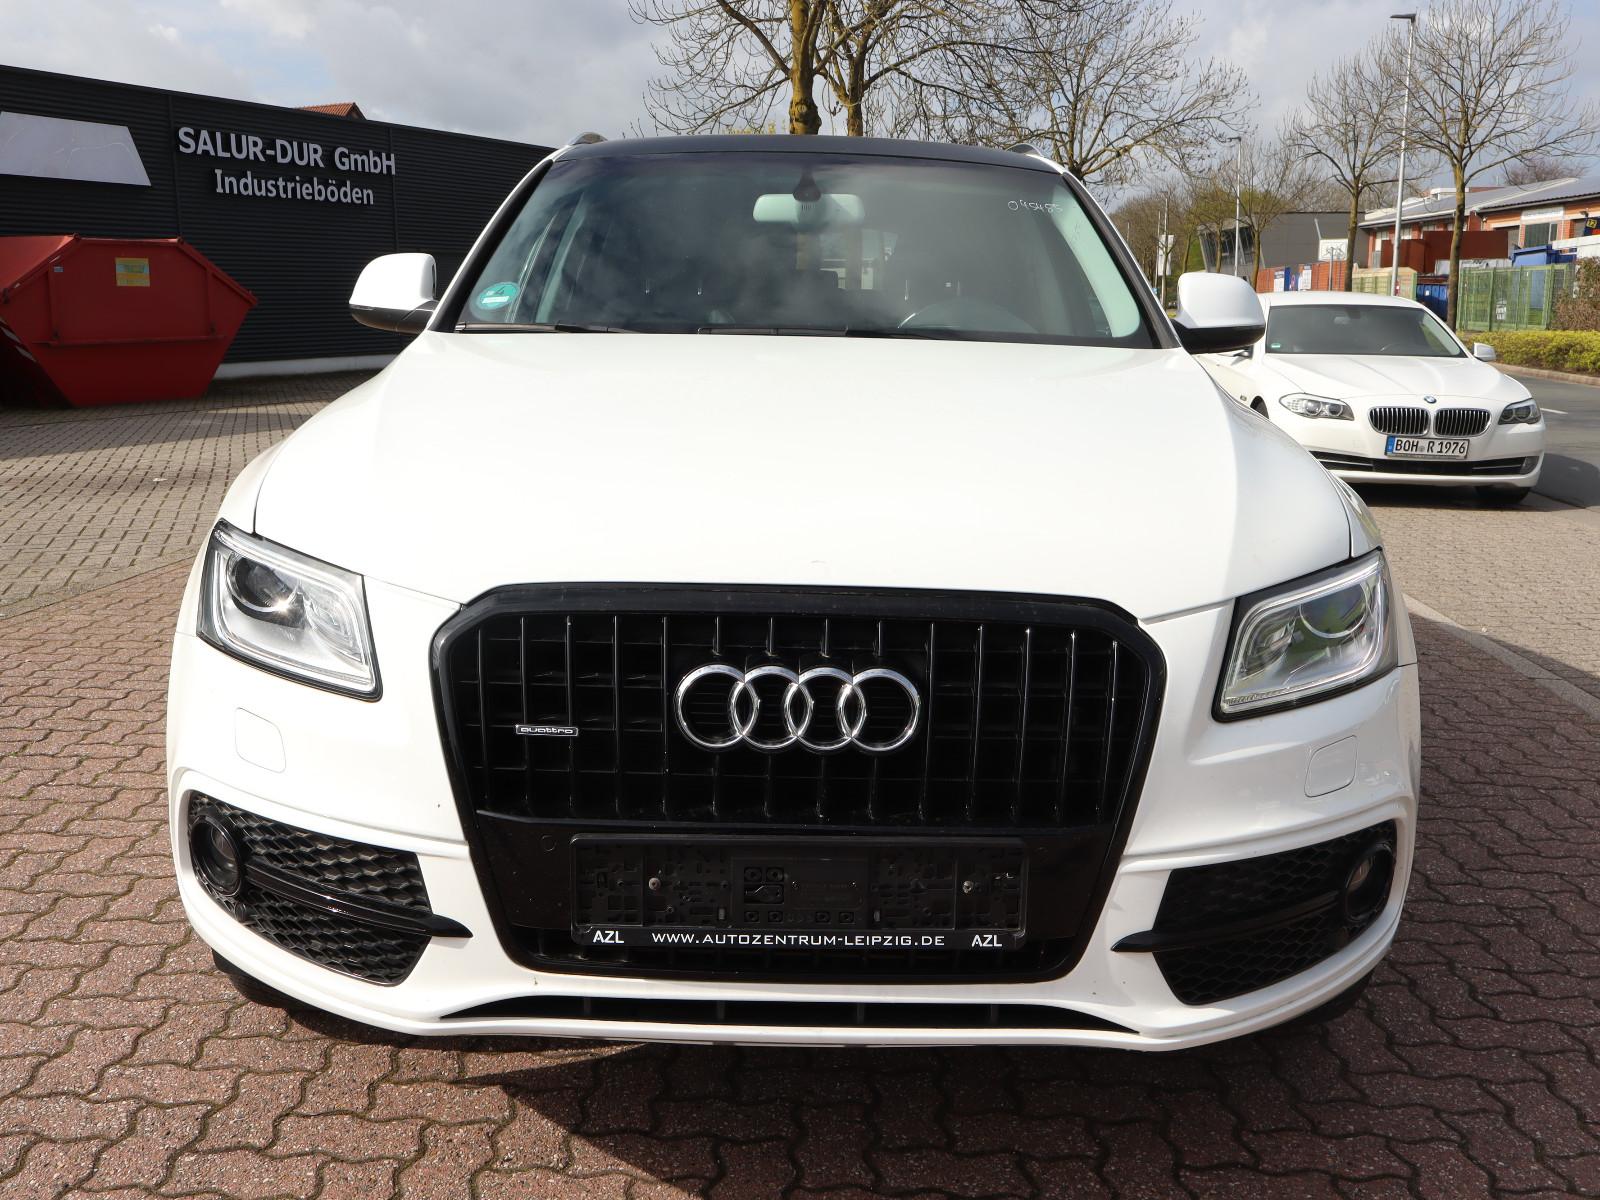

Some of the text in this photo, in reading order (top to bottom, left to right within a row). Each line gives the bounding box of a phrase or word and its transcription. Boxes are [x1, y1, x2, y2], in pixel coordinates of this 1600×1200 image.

[177, 126, 396, 176] SALUR-DUR GmbH
[214, 168, 374, 206] Industrieböden
[1395, 439, 1466, 454] BOH R 1976
[593, 930, 1003, 947] AZL WWW.AUTOZENTRUM-LEIPZIG.DE AZL
